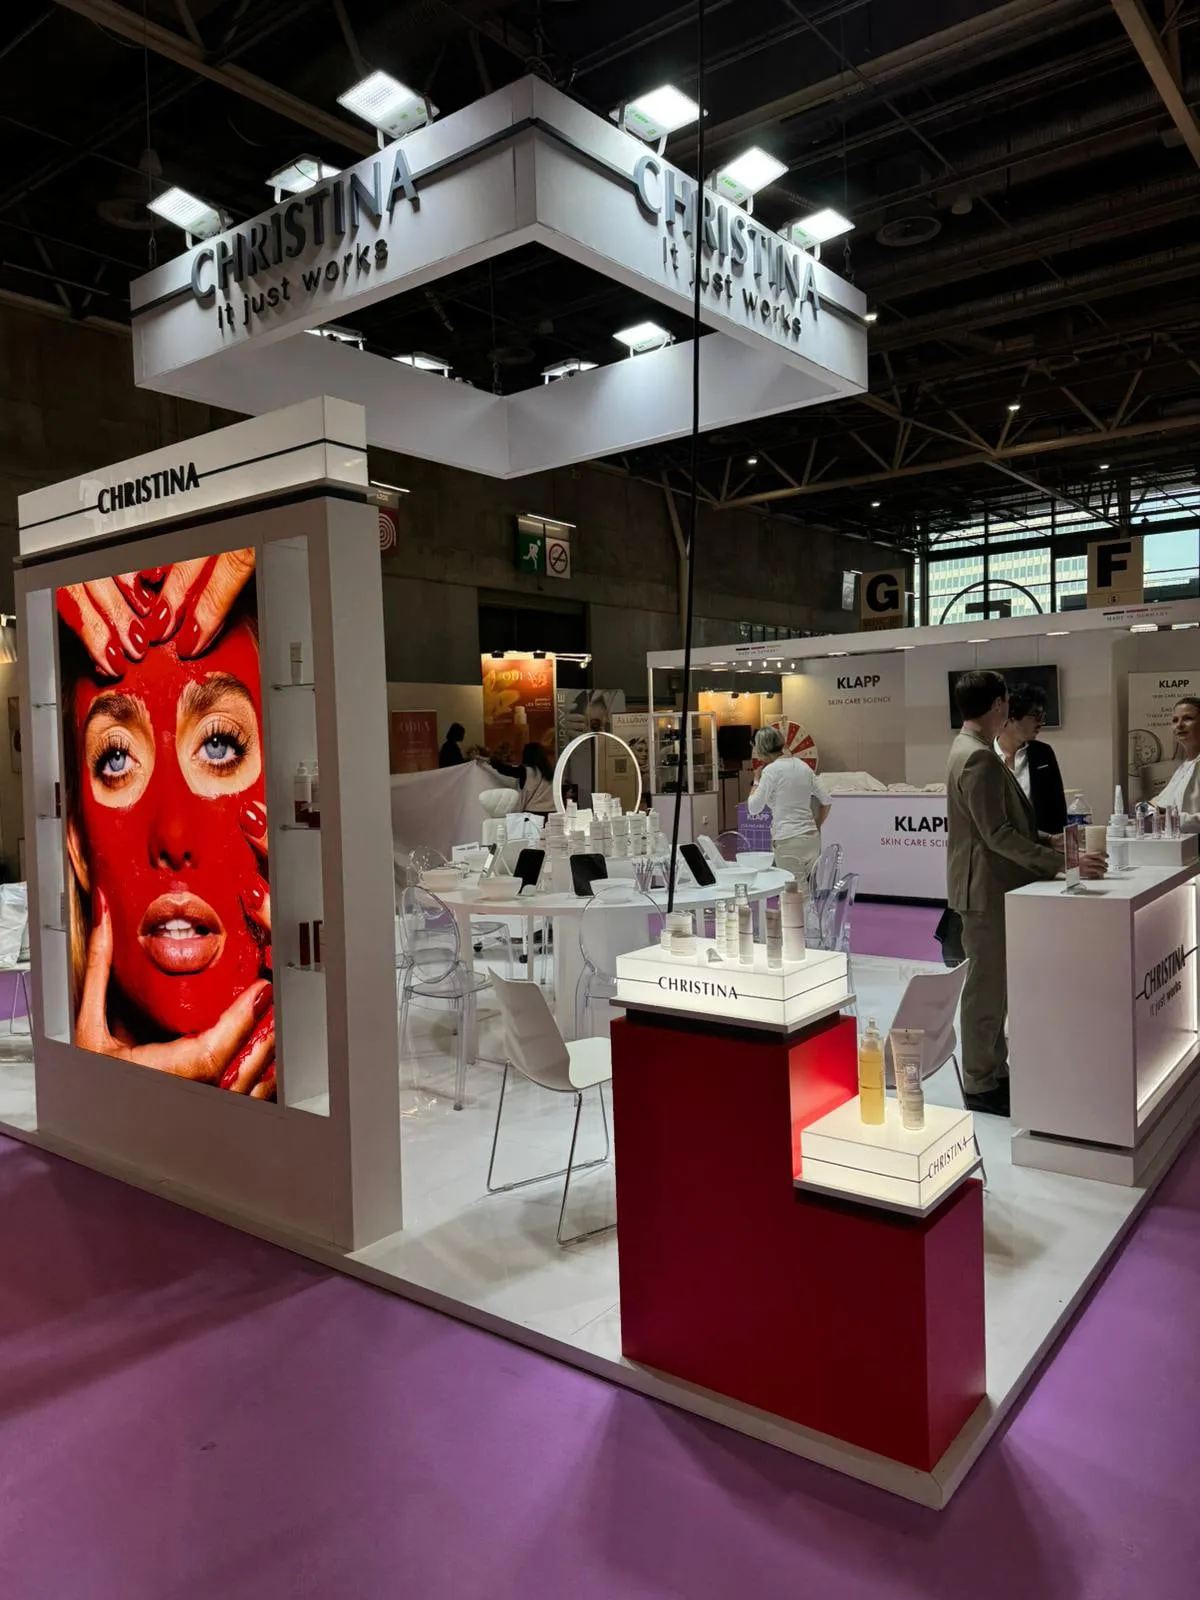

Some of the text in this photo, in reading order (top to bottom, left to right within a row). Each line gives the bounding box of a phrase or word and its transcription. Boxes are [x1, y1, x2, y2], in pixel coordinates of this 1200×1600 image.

[191, 149, 420, 301] CHRISTINA
[633, 155, 821, 314] CHRISTINA
[218, 238, 389, 328] It just works
[663, 236, 802, 334] It just works
[97, 462, 201, 514] CHRISTINA
[1097, 542, 1132, 588] F
[867, 573, 900, 612] G
[828, 695, 892, 706] SKIN CARE SCIENCE
[837, 675, 881, 690] KLAPP
[1159, 680, 1190, 688] KLAPP
[880, 837, 948, 848] SKIN CARE SCI
[658, 976, 739, 1000] CHRISTINA
[1144, 944, 1186, 1000] CHRISTINA
[928, 1137, 968, 1179] CHRISTINA
